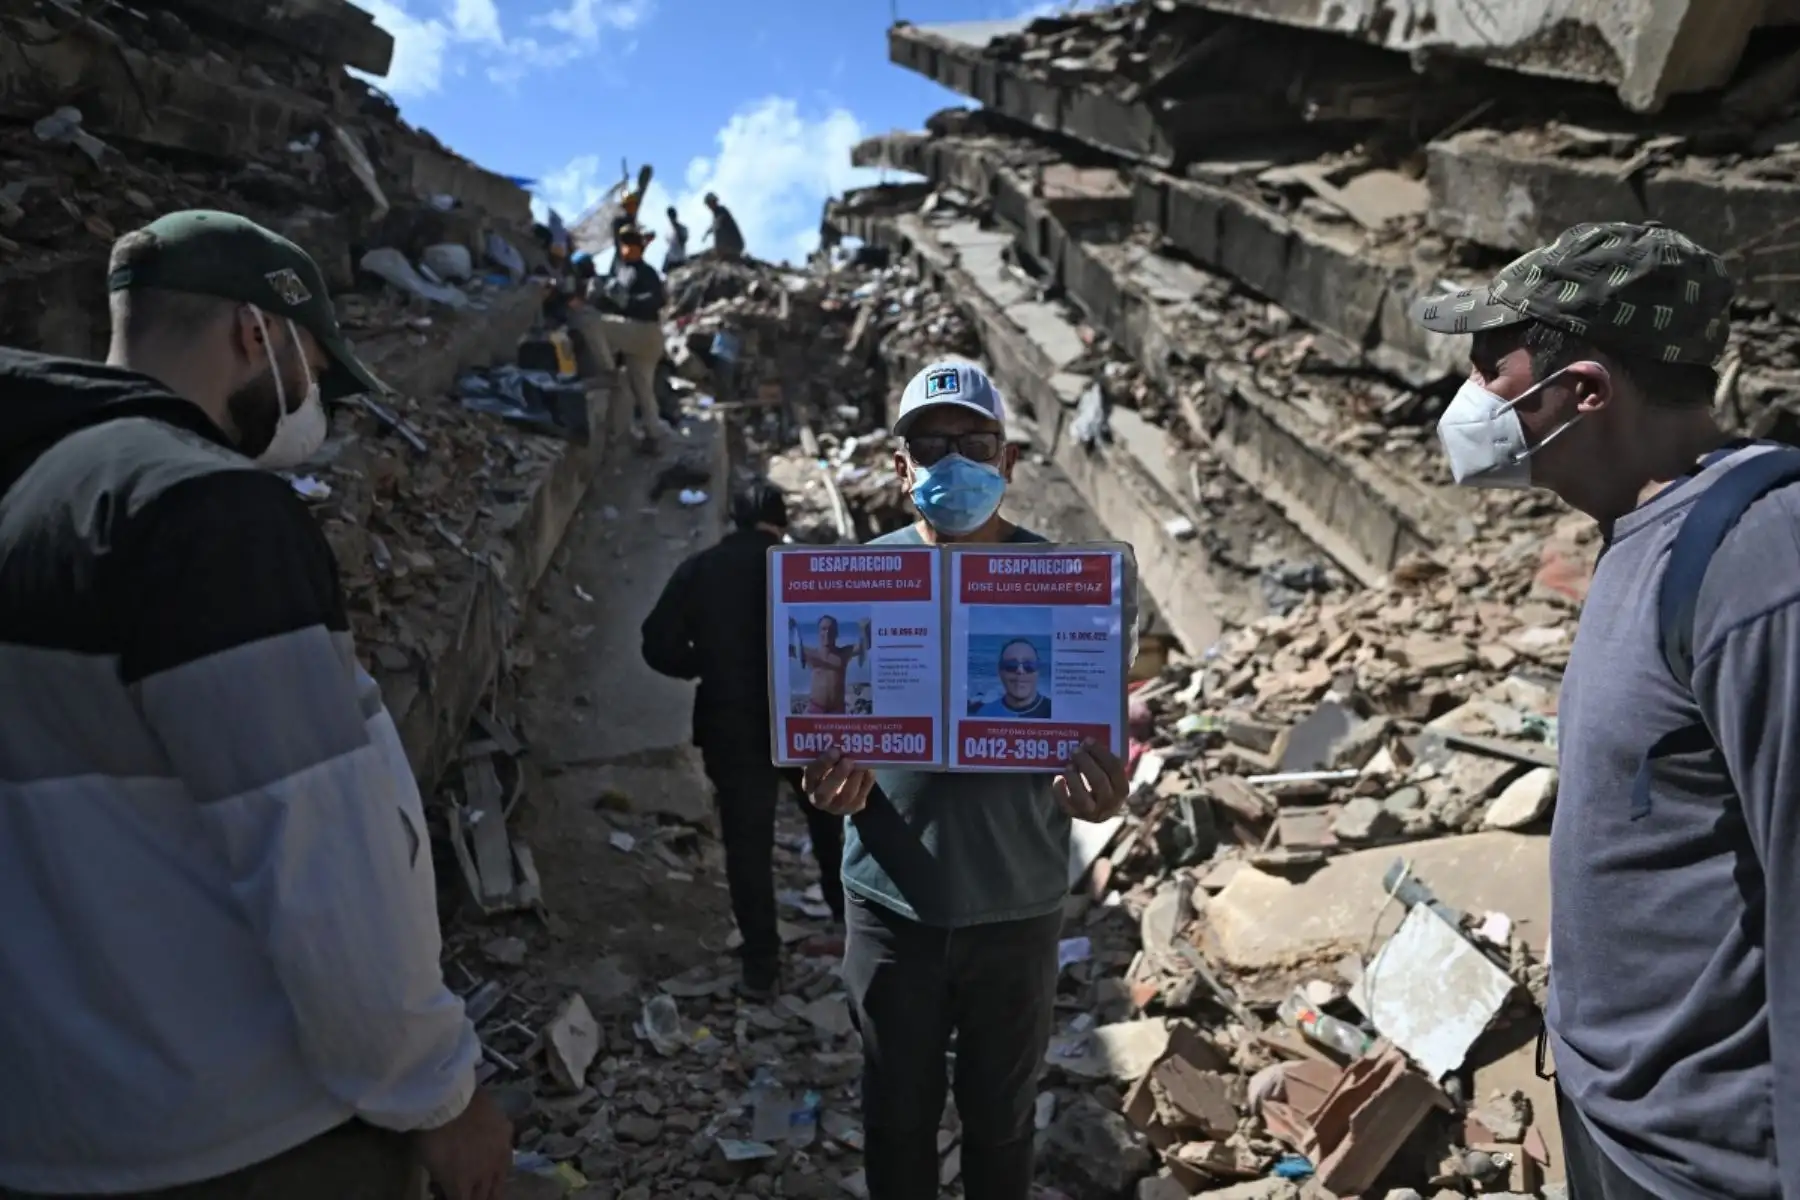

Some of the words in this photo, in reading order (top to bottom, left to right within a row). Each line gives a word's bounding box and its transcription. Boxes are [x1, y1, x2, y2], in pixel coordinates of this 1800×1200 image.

[810, 556, 902, 573] DESAPARECIDO
[988, 558, 1083, 575] DESAPARECIDO
[788, 580, 815, 591] JOSE
[818, 580, 844, 591] LUIS
[845, 579, 892, 589] CUMARE
[896, 579, 922, 589] DIAZ
[996, 582, 1021, 592] LUIS
[1024, 582, 1072, 592] CUMARE
[1075, 582, 1103, 592] DIAZ
[793, 732, 926, 754] 0412-399-8500
